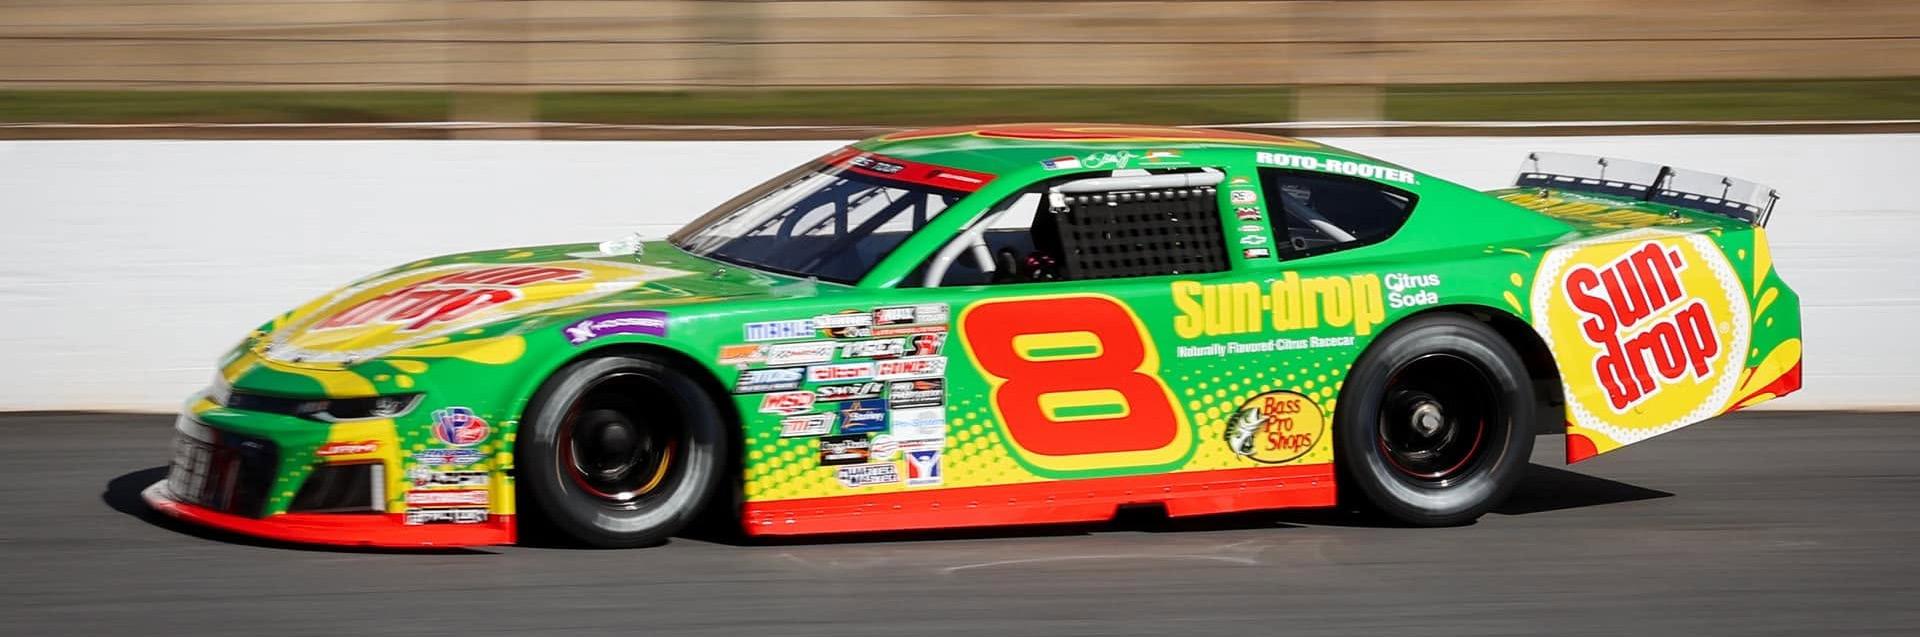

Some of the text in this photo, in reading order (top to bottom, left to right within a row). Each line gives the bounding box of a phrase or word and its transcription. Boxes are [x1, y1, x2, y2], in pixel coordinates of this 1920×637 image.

[1384, 272, 1440, 292] Citrus
[1171, 271, 1385, 339] Sun-drop
[1388, 290, 1439, 308] Soda
[1176, 342, 1227, 358] Naturally
[1310, 336, 1356, 349] Racecar
[1595, 302, 1718, 409] drop
[957, 292, 1192, 470] 8
[1264, 397, 1300, 415] Bass
[1264, 415, 1293, 432] Pro
[1266, 432, 1312, 452] Shops
